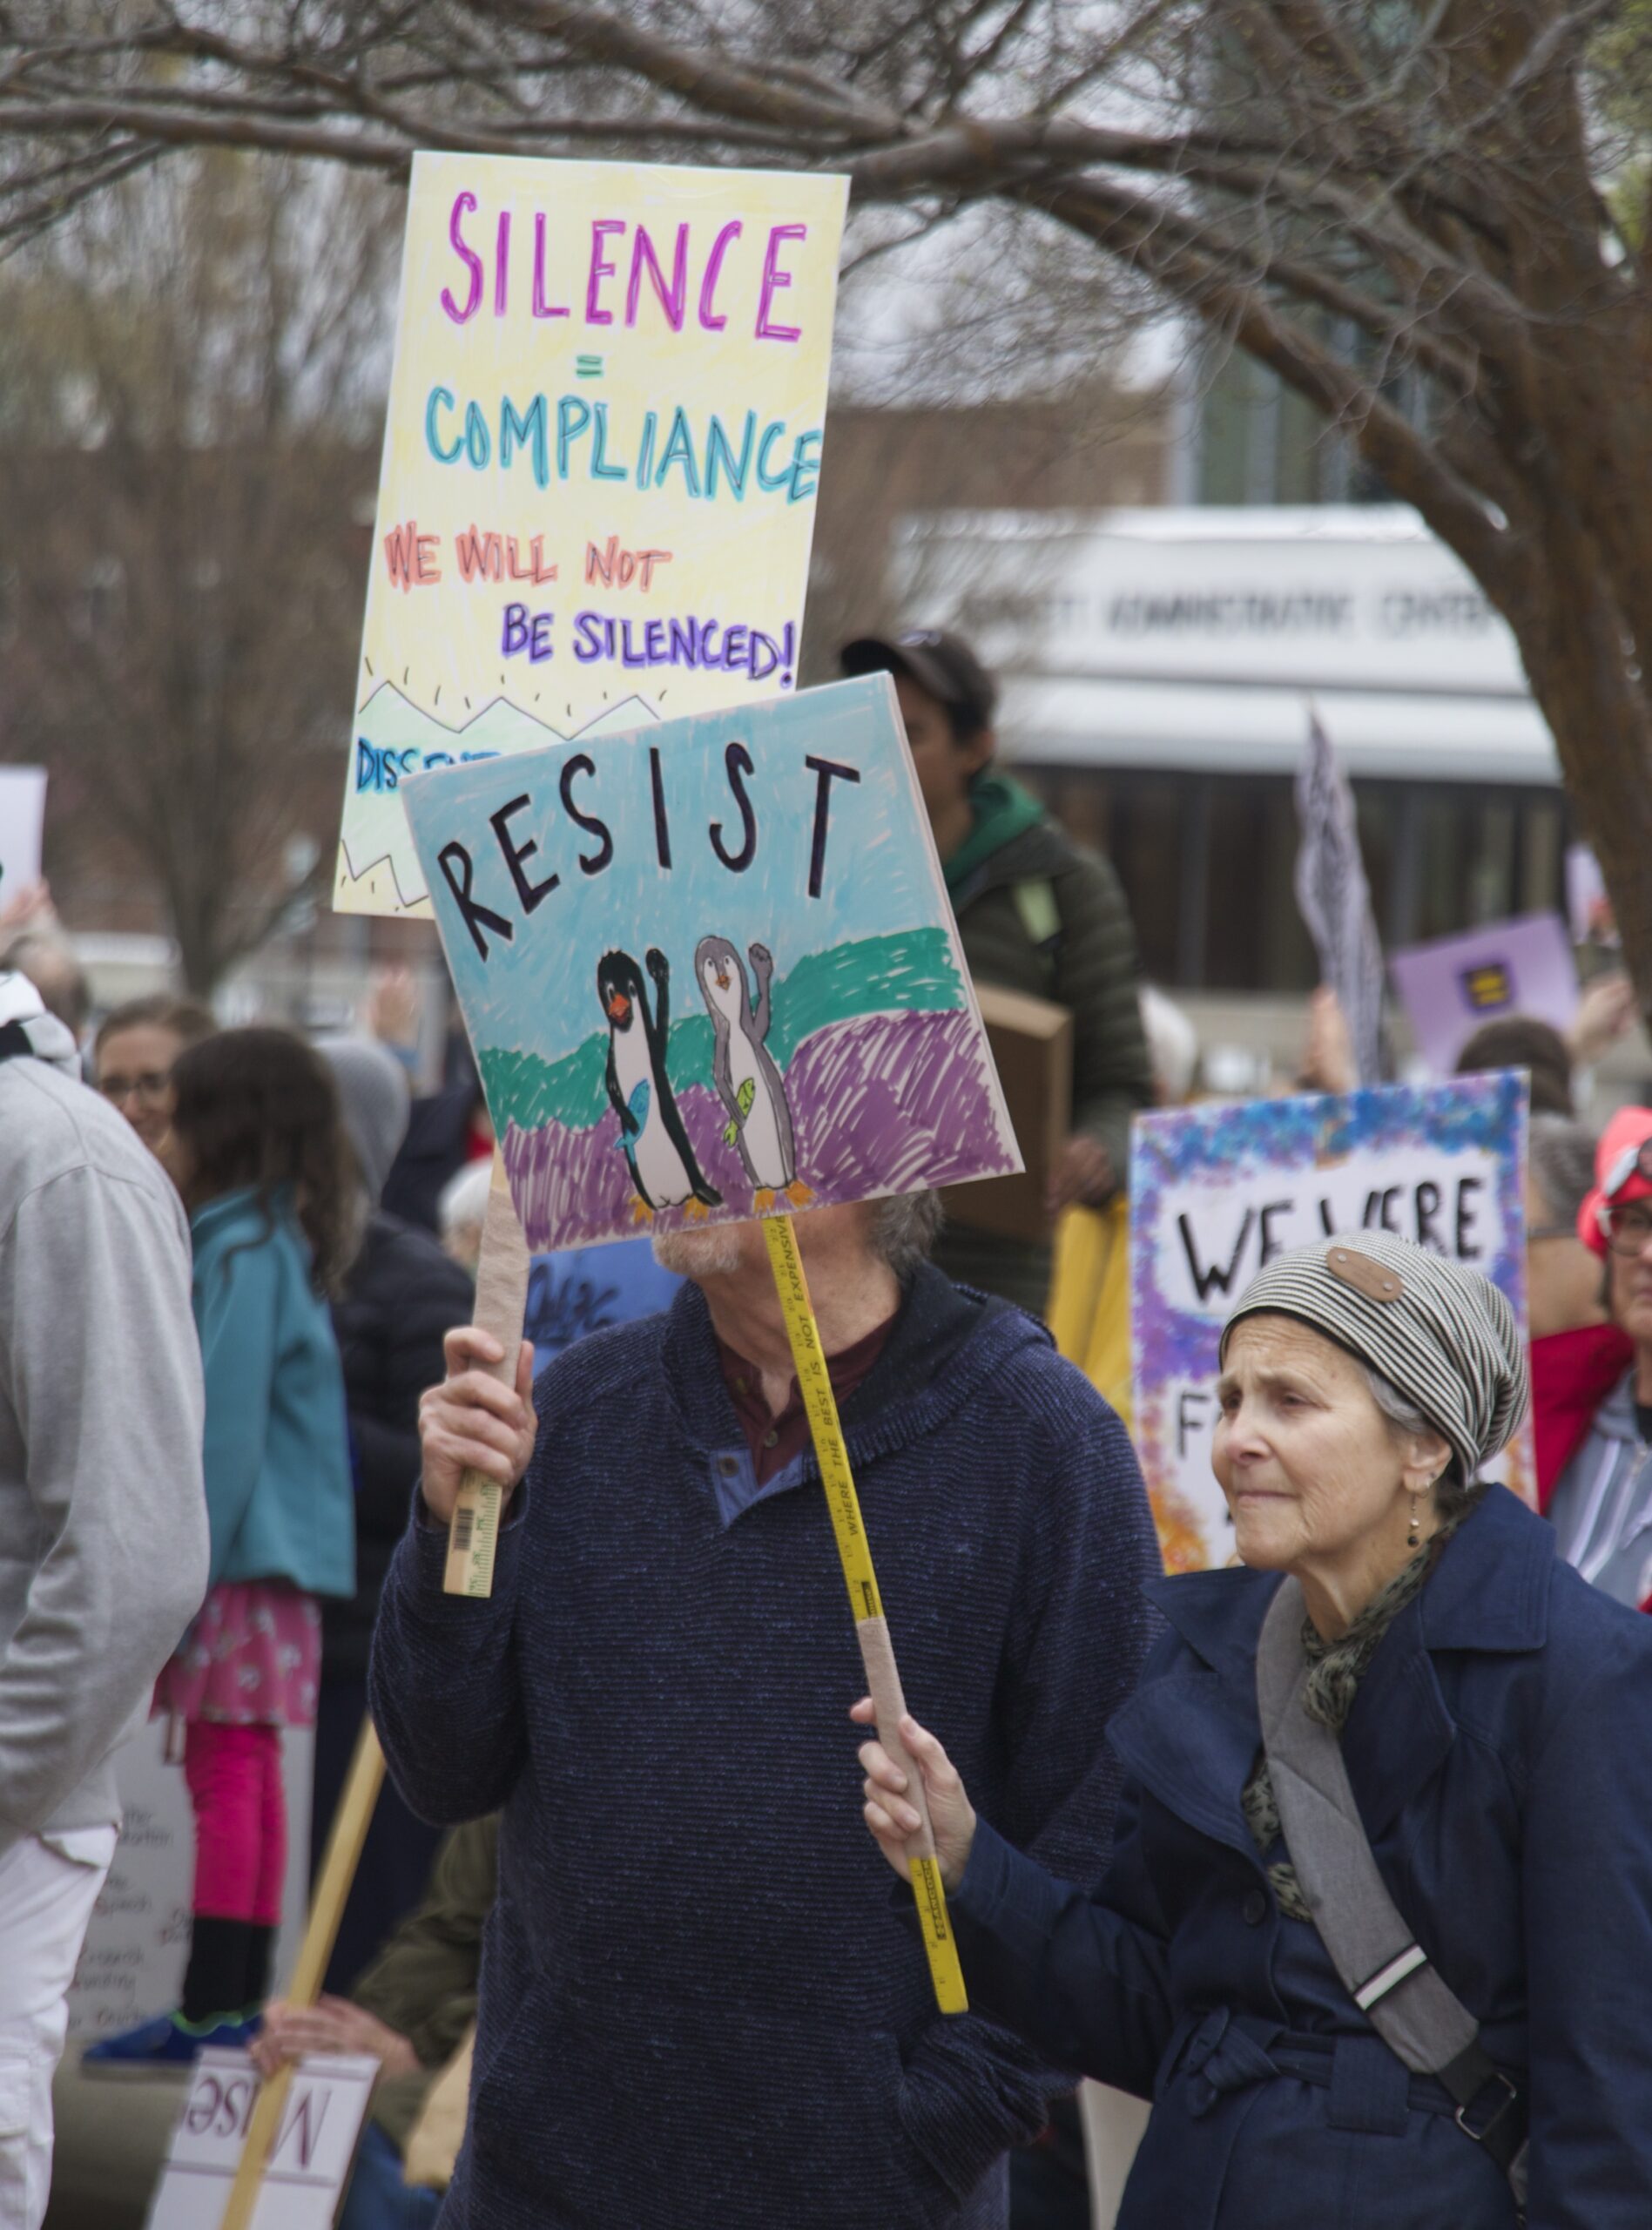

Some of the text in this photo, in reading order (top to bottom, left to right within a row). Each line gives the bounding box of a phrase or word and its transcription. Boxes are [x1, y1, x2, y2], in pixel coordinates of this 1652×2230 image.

[441, 191, 807, 342] SILENCE
[425, 386, 824, 504] COMPLIANCE
[384, 521, 673, 593] WE WILL NOT
[502, 602, 796, 688] BE SILENCED!
[438, 743, 860, 962] RESIST
[776, 1215, 805, 1302] EXPENSIVE
[799, 1314, 816, 1350] NOT
[810, 1361, 822, 1376] IS
[816, 1388, 833, 1426] BEST
[828, 1438, 843, 1467] THE
[838, 1480, 858, 1537] WHERE
